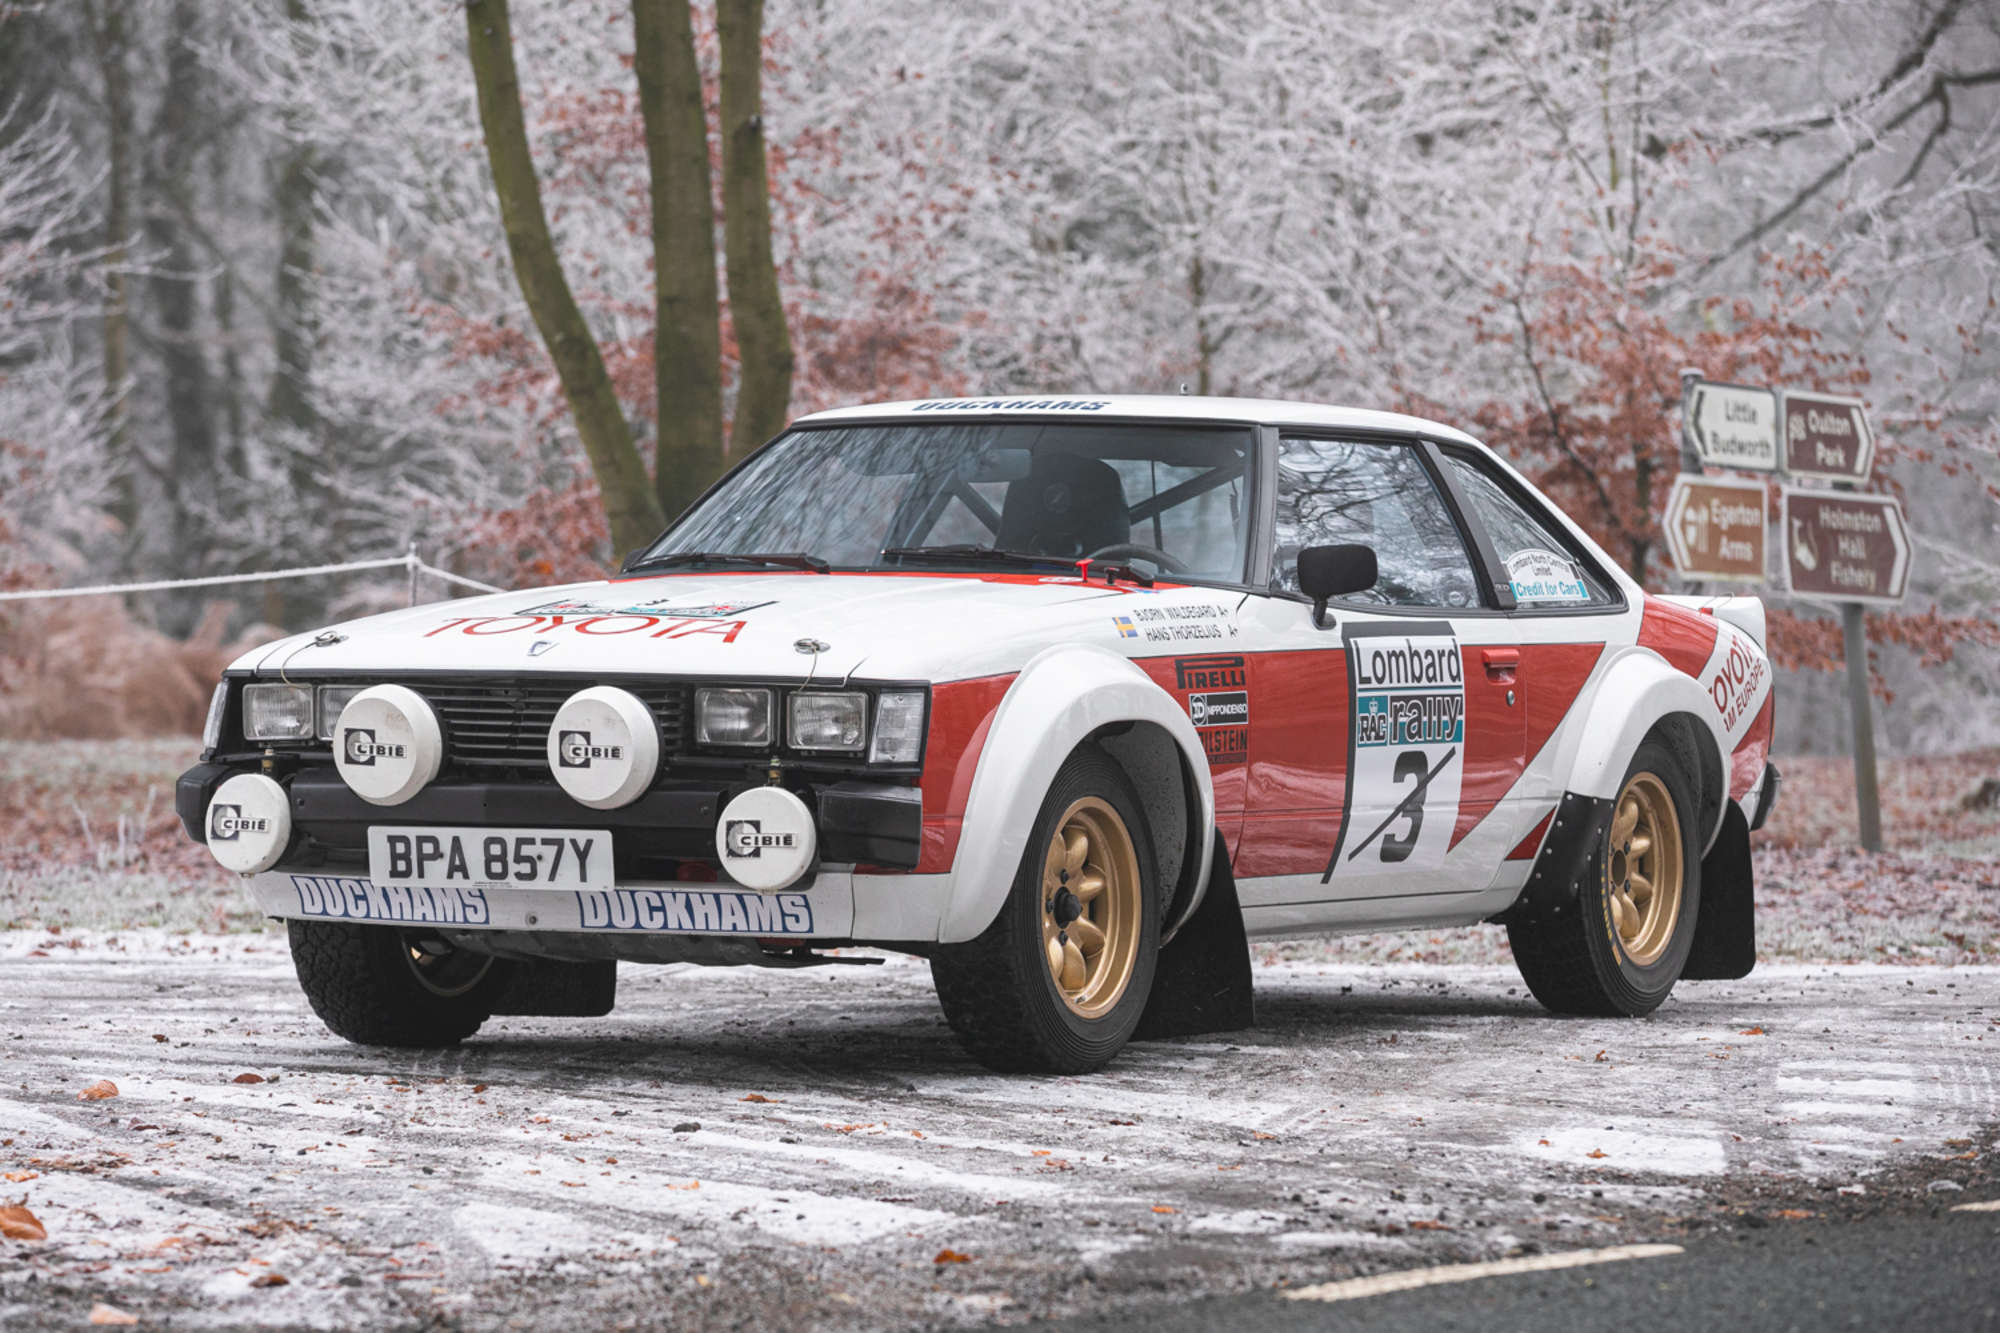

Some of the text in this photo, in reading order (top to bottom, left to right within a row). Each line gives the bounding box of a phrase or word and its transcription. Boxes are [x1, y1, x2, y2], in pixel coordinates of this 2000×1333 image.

[1816, 441, 1845, 468] Park
[1719, 535, 1753, 561] Arms
[1516, 582, 1545, 597] Credit
[1558, 580, 1580, 595] Cars
[423, 615, 747, 643] TOYOTA
[1144, 626, 1171, 642] HANS
[1174, 656, 1246, 690] PIRELLI
[1353, 639, 1461, 685] Lombard
[1359, 712, 1387, 744] RAC
[1391, 696, 1461, 744] rally
[1380, 750, 1428, 862] 3
[387, 834, 594, 883] BPA 857Y
[295, 876, 487, 924] DUCKHAMS
[580, 891, 811, 933] DUCKHAMS
